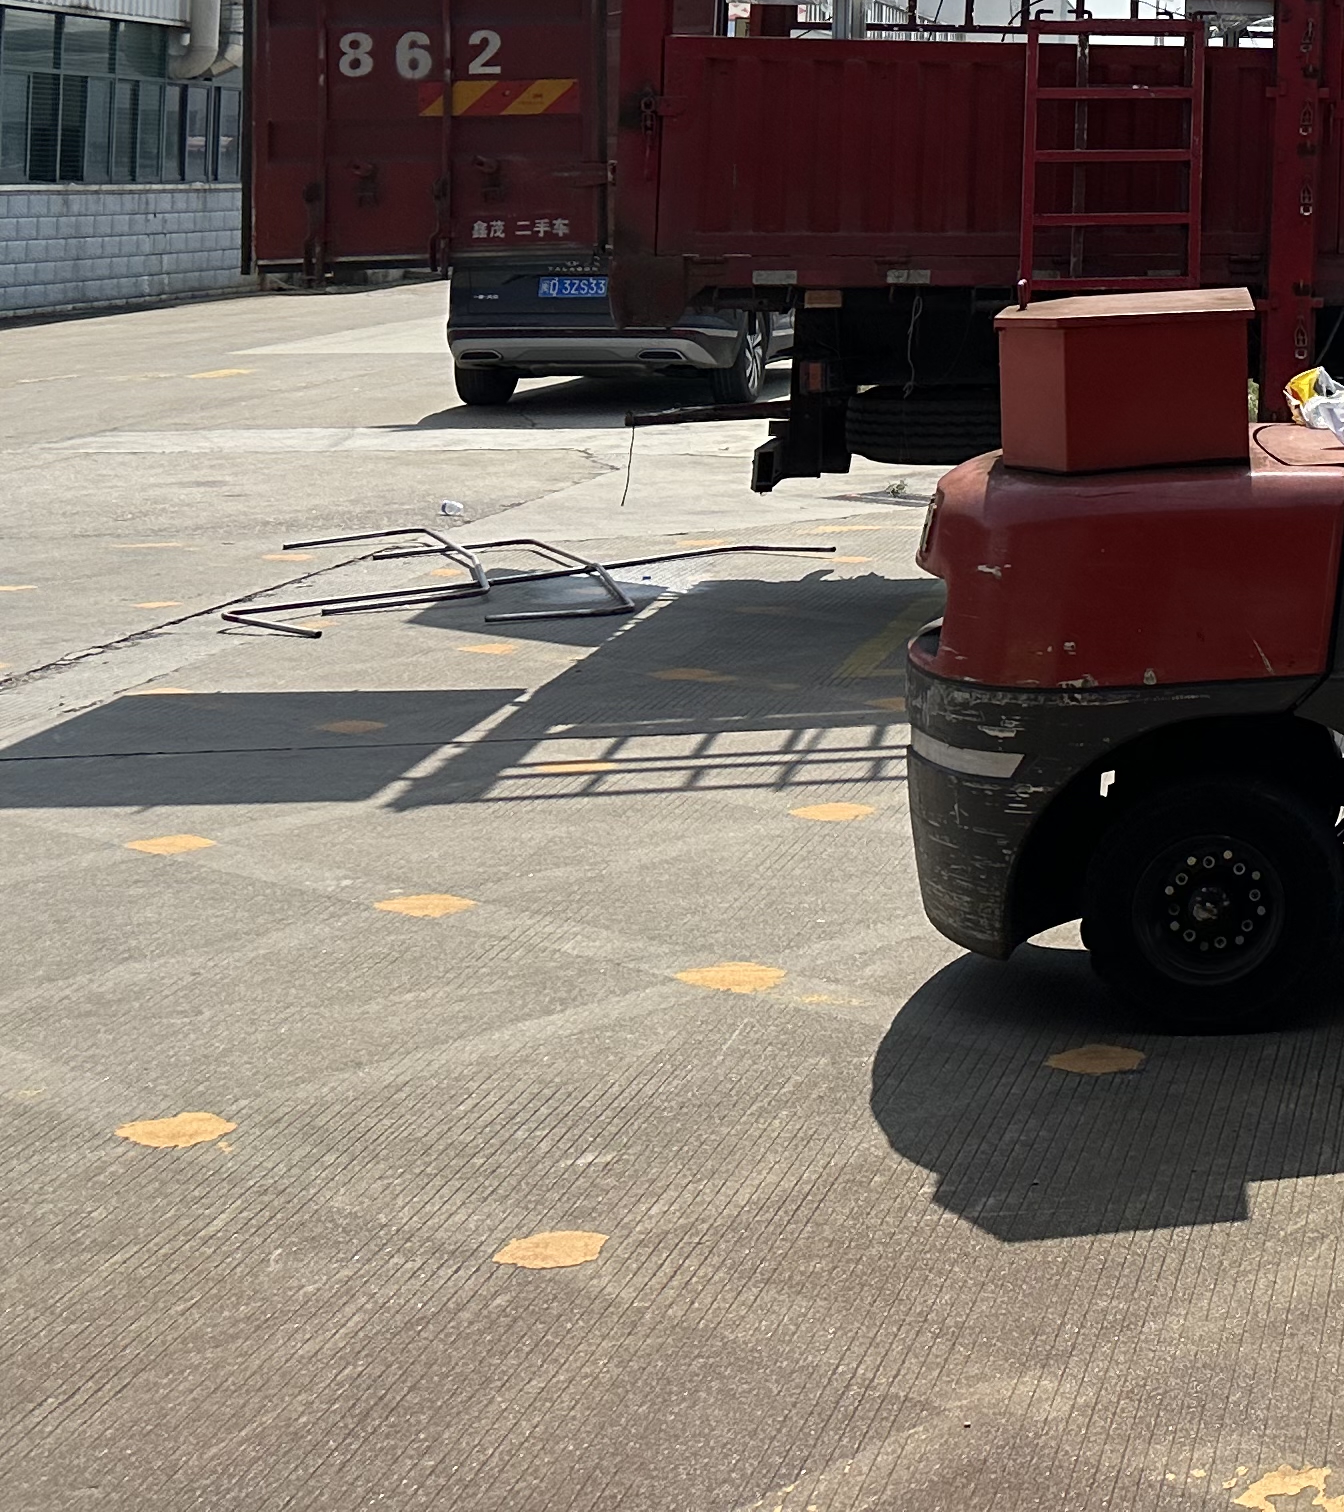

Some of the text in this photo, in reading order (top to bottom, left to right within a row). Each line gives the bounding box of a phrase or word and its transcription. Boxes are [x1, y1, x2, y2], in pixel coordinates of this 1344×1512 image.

[471, 218, 570, 238] 鑫茂 二手车
